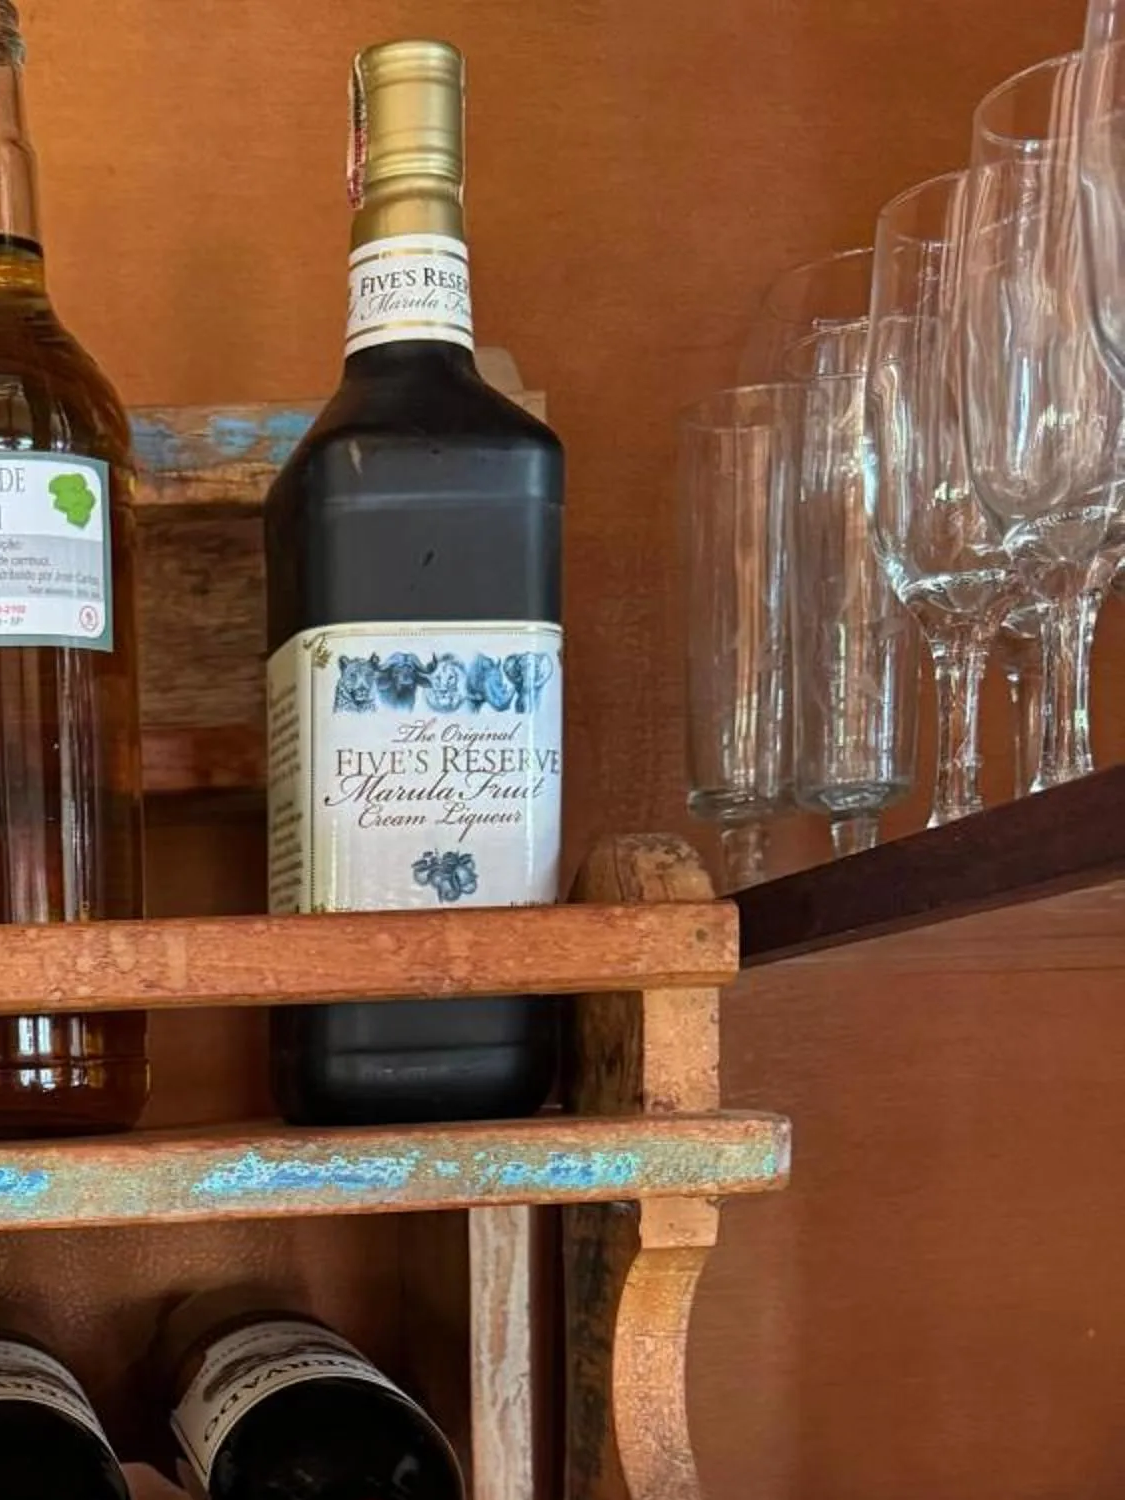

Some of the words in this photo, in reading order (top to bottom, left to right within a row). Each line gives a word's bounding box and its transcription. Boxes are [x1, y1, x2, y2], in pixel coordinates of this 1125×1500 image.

[360, 268, 416, 297] FIVE'S
[360, 288, 439, 320] Marula
[391, 718, 436, 743] The
[440, 720, 523, 753] Original
[336, 749, 429, 777] FIVE'S
[441, 748, 561, 774] RESERVE
[325, 770, 456, 807] Marula
[458, 770, 543, 802] Fruit
[358, 801, 427, 829] Cream
[435, 801, 523, 842] Liqueur
